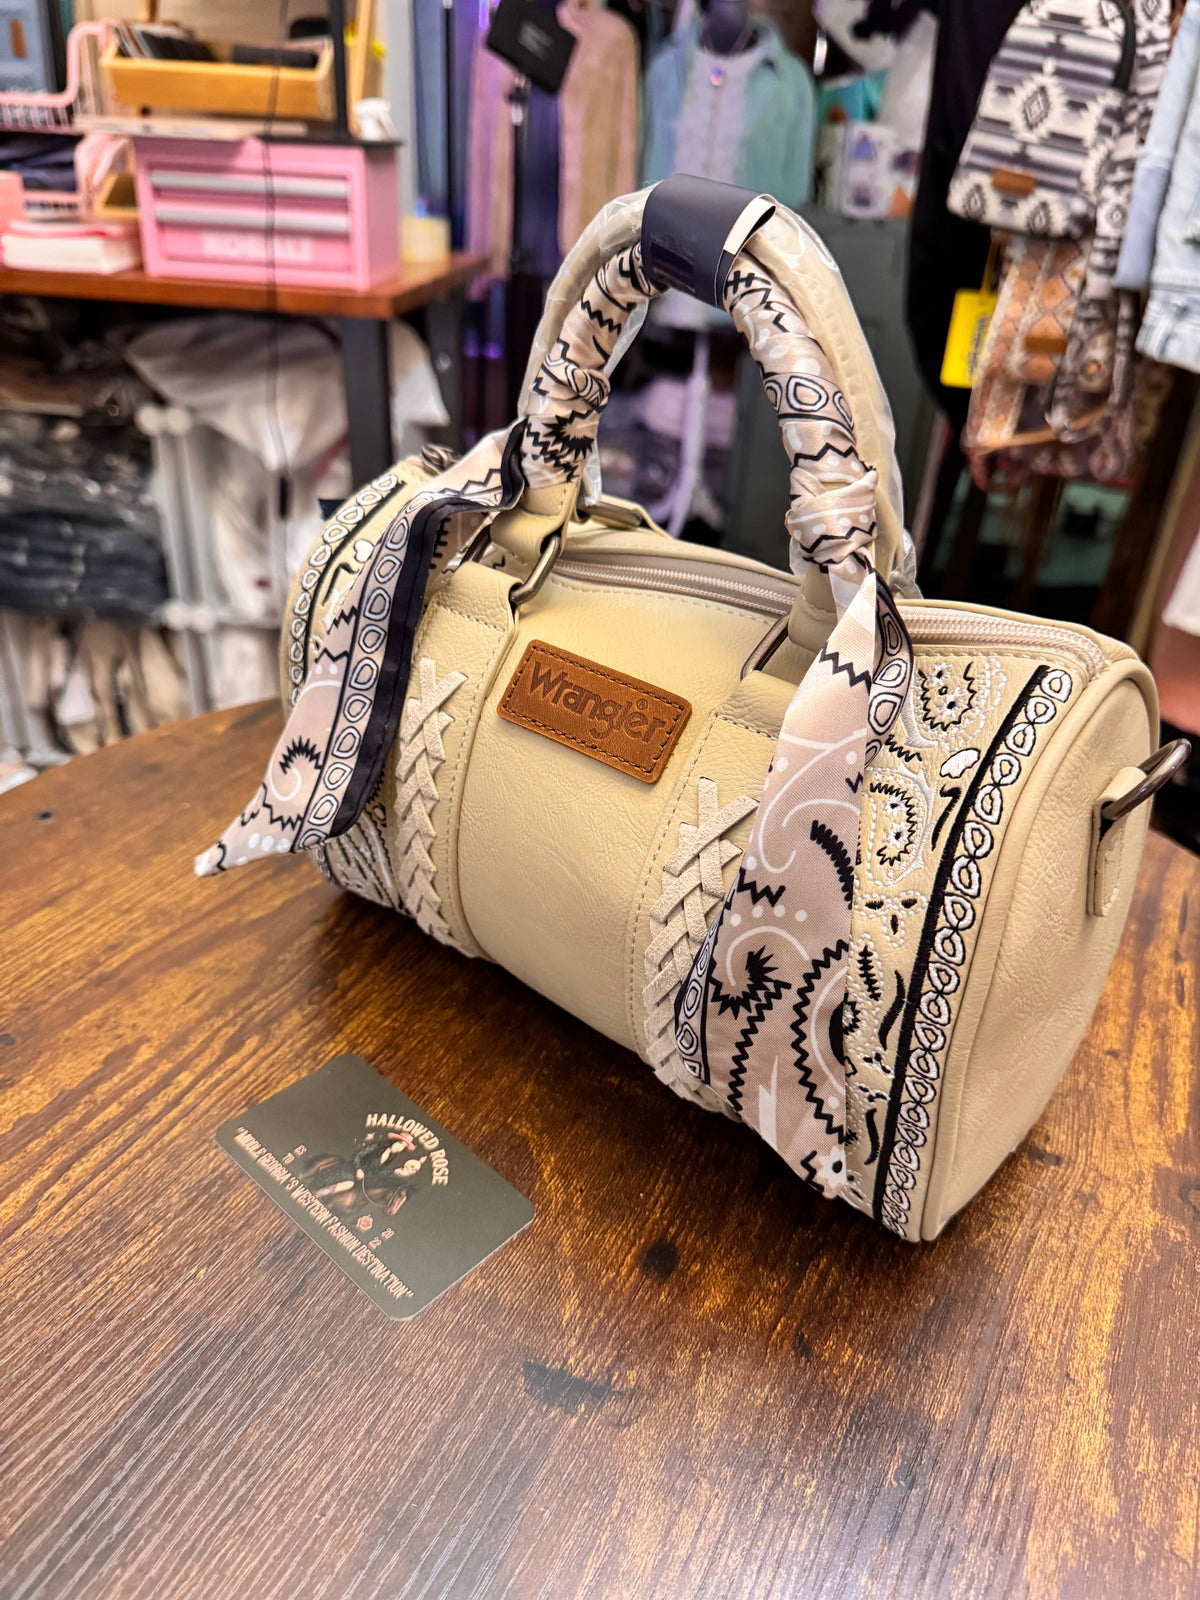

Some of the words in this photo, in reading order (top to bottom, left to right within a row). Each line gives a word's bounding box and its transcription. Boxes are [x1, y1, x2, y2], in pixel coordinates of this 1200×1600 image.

[365, 1113, 440, 1150] HALLOWED
[429, 1148, 449, 1187] ROSE
[290, 1183, 333, 1225] WESTERN
[321, 1215, 362, 1254] FASHION
